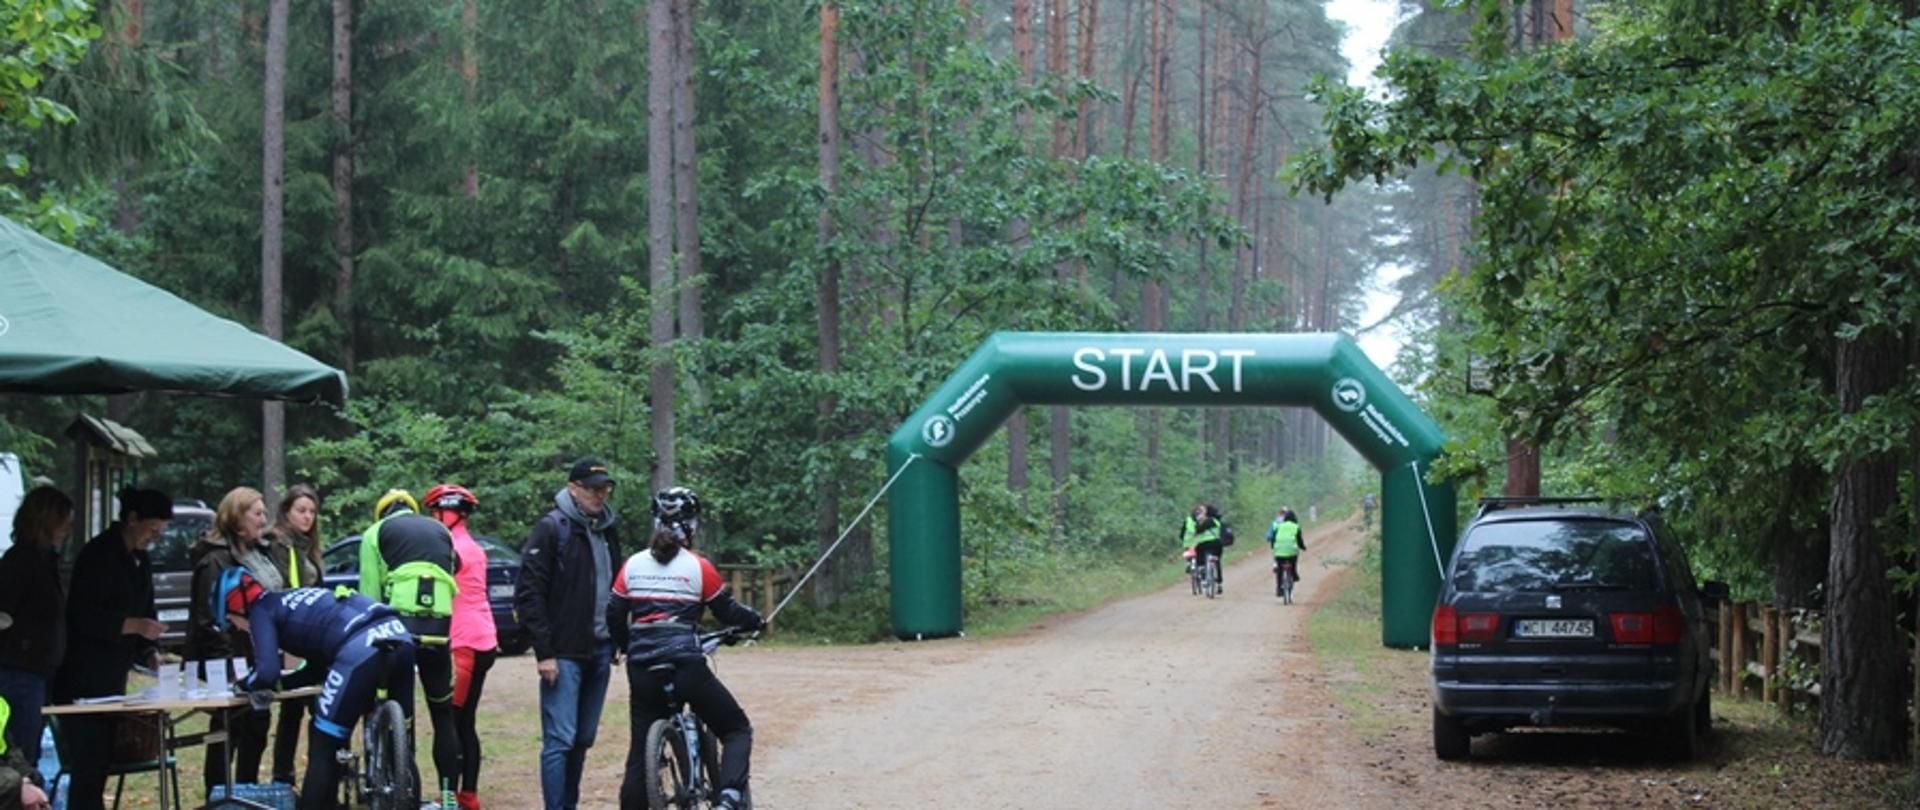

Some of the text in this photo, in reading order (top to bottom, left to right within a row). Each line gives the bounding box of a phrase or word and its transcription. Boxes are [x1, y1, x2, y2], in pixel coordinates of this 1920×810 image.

[1071, 347, 1256, 392] START
[365, 619, 406, 647] AKO
[1551, 621, 1592, 634] 44745
[319, 669, 343, 715] AKO
